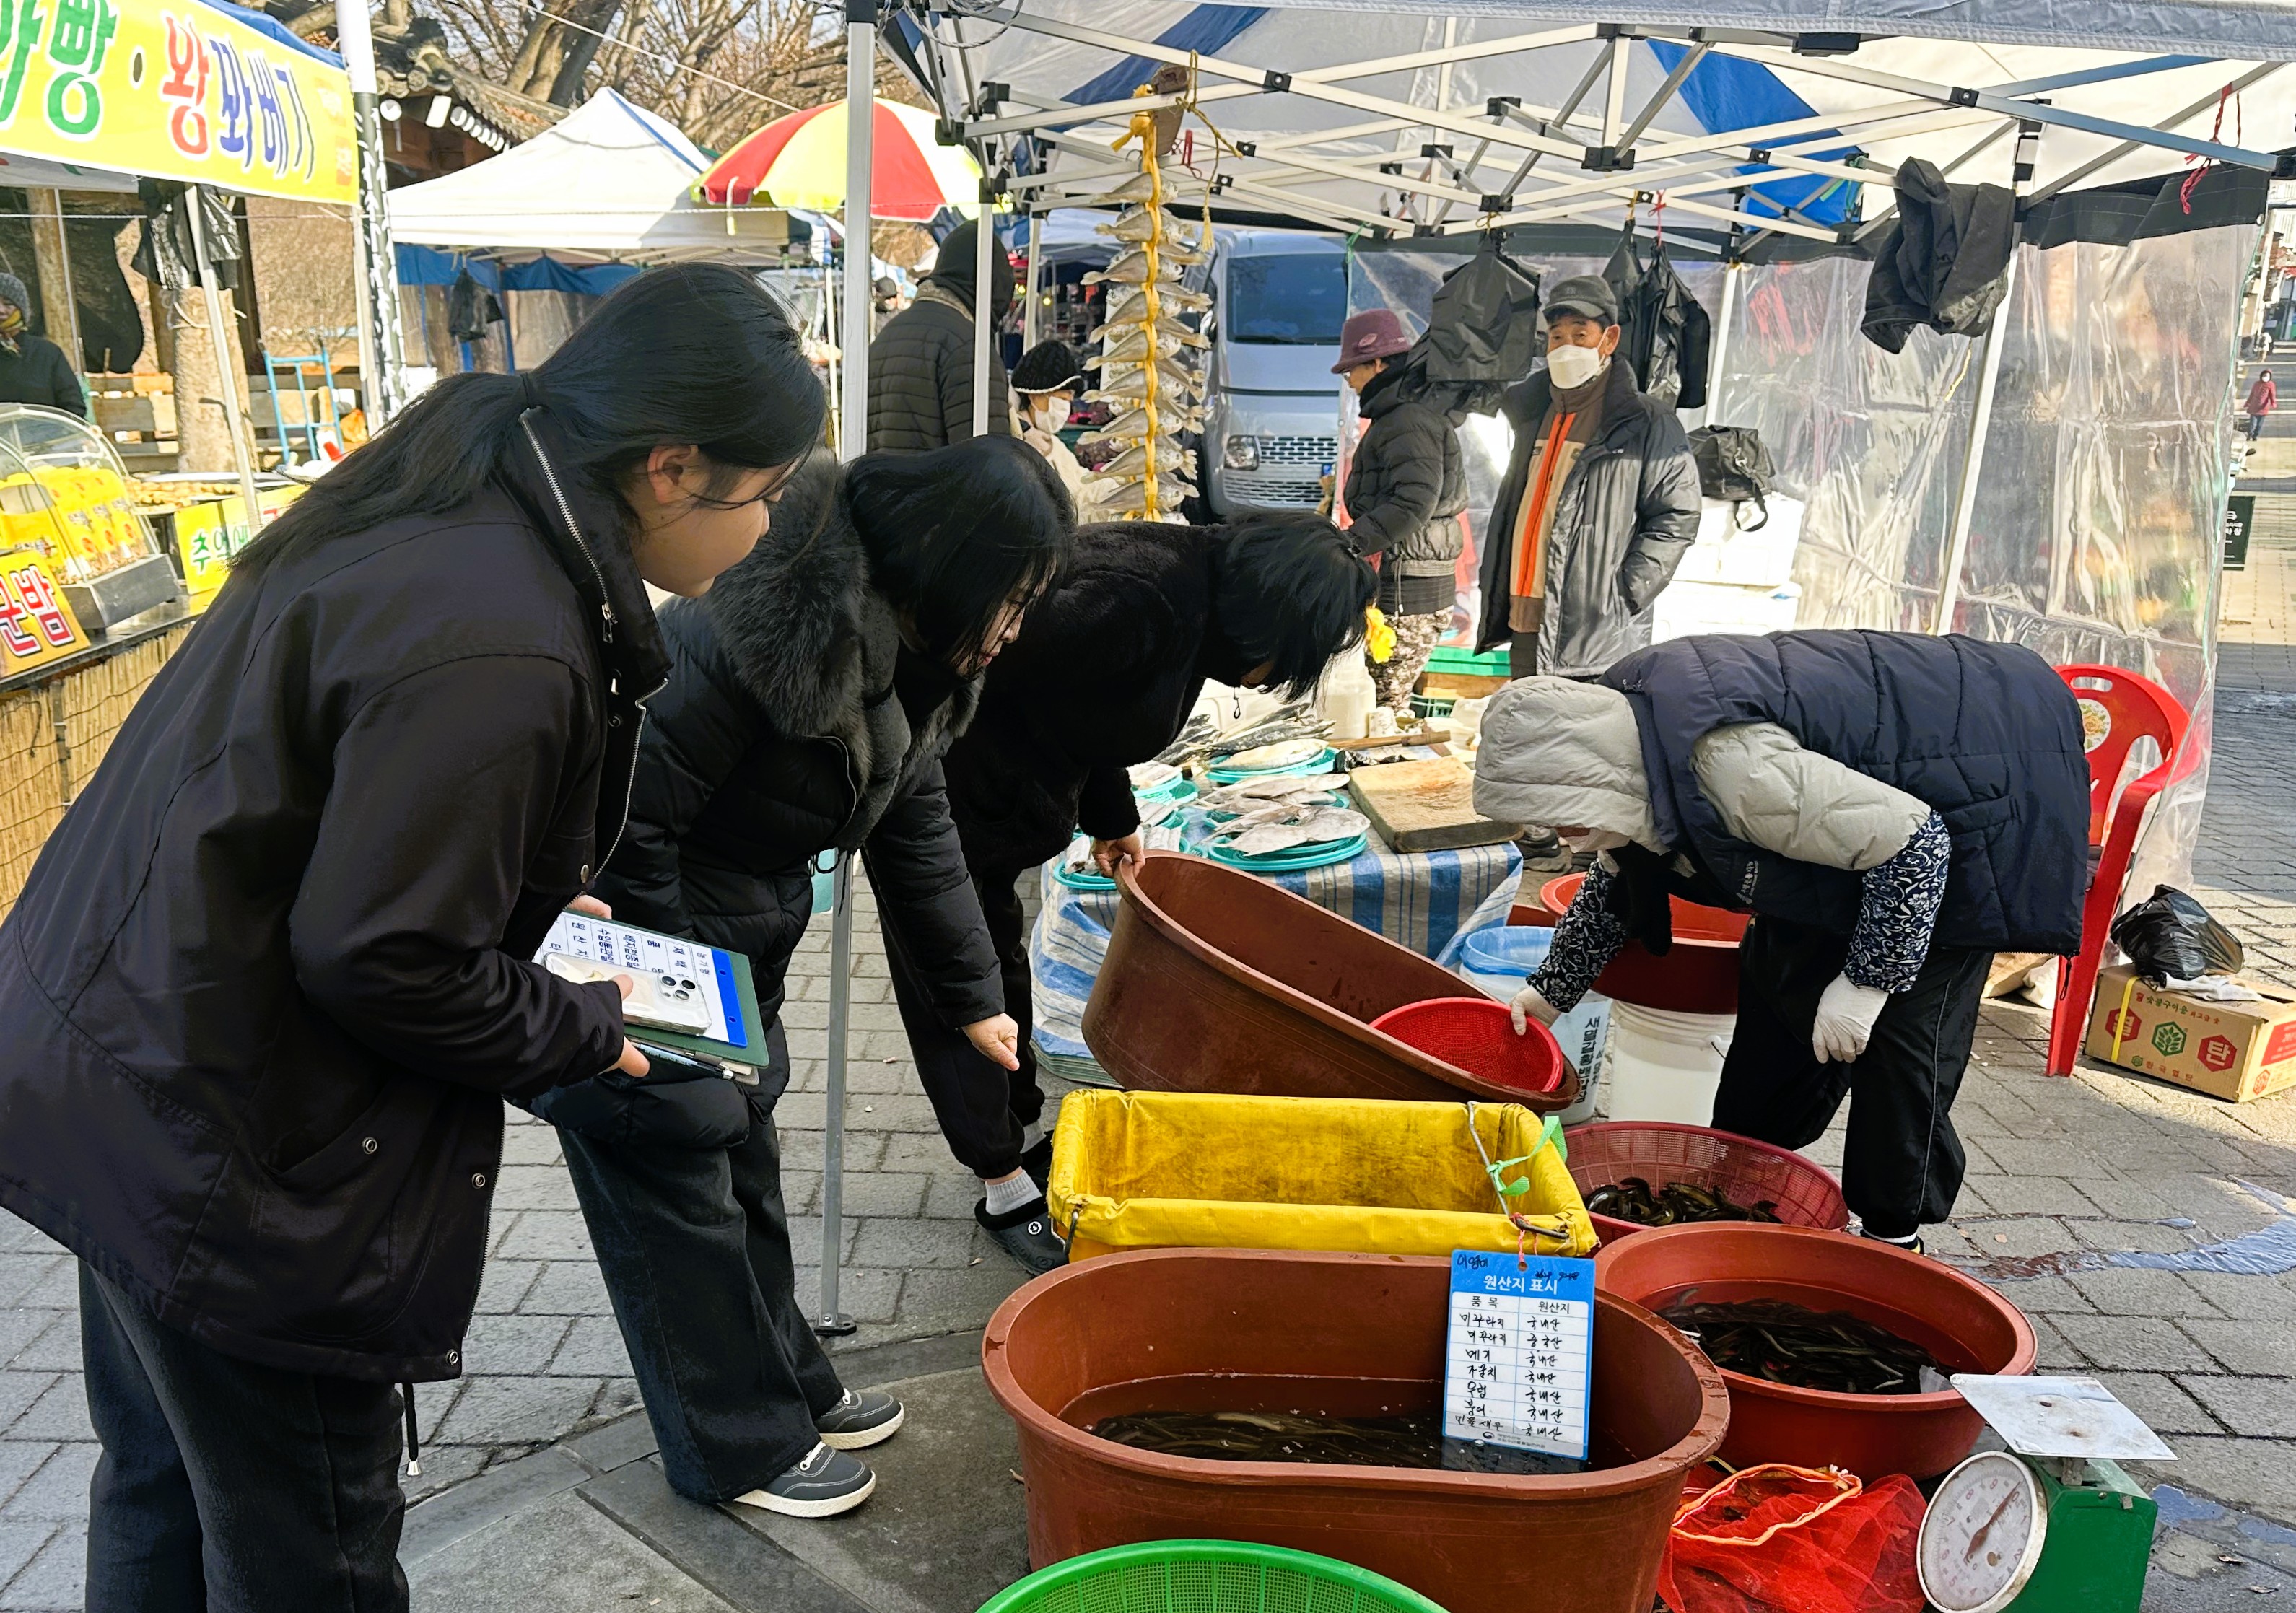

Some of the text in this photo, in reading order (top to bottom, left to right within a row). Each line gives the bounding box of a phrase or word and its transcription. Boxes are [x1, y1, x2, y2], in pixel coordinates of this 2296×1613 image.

[2206, 1040, 2231, 1066] 탄
[1483, 1275, 1558, 1295] 원산지 표시
[1538, 1301, 1570, 1314] 원산지
[1459, 1312, 1504, 1328] 미꾸라지
[1527, 1316, 1560, 1332] 국내산
[1467, 1330, 1506, 1345] 미꾸라지
[1527, 1333, 1563, 1349] 중국산
[1465, 1349, 1490, 1363] 메기
[1525, 1351, 1558, 1368] 국내산
[1467, 1363, 1497, 1382] 가물치
[1525, 1370, 1557, 1385] 국내산
[1525, 1387, 1561, 1404] 국내산
[1527, 1404, 1563, 1423] 국내산
[1521, 1423, 1563, 1441] 국내산
